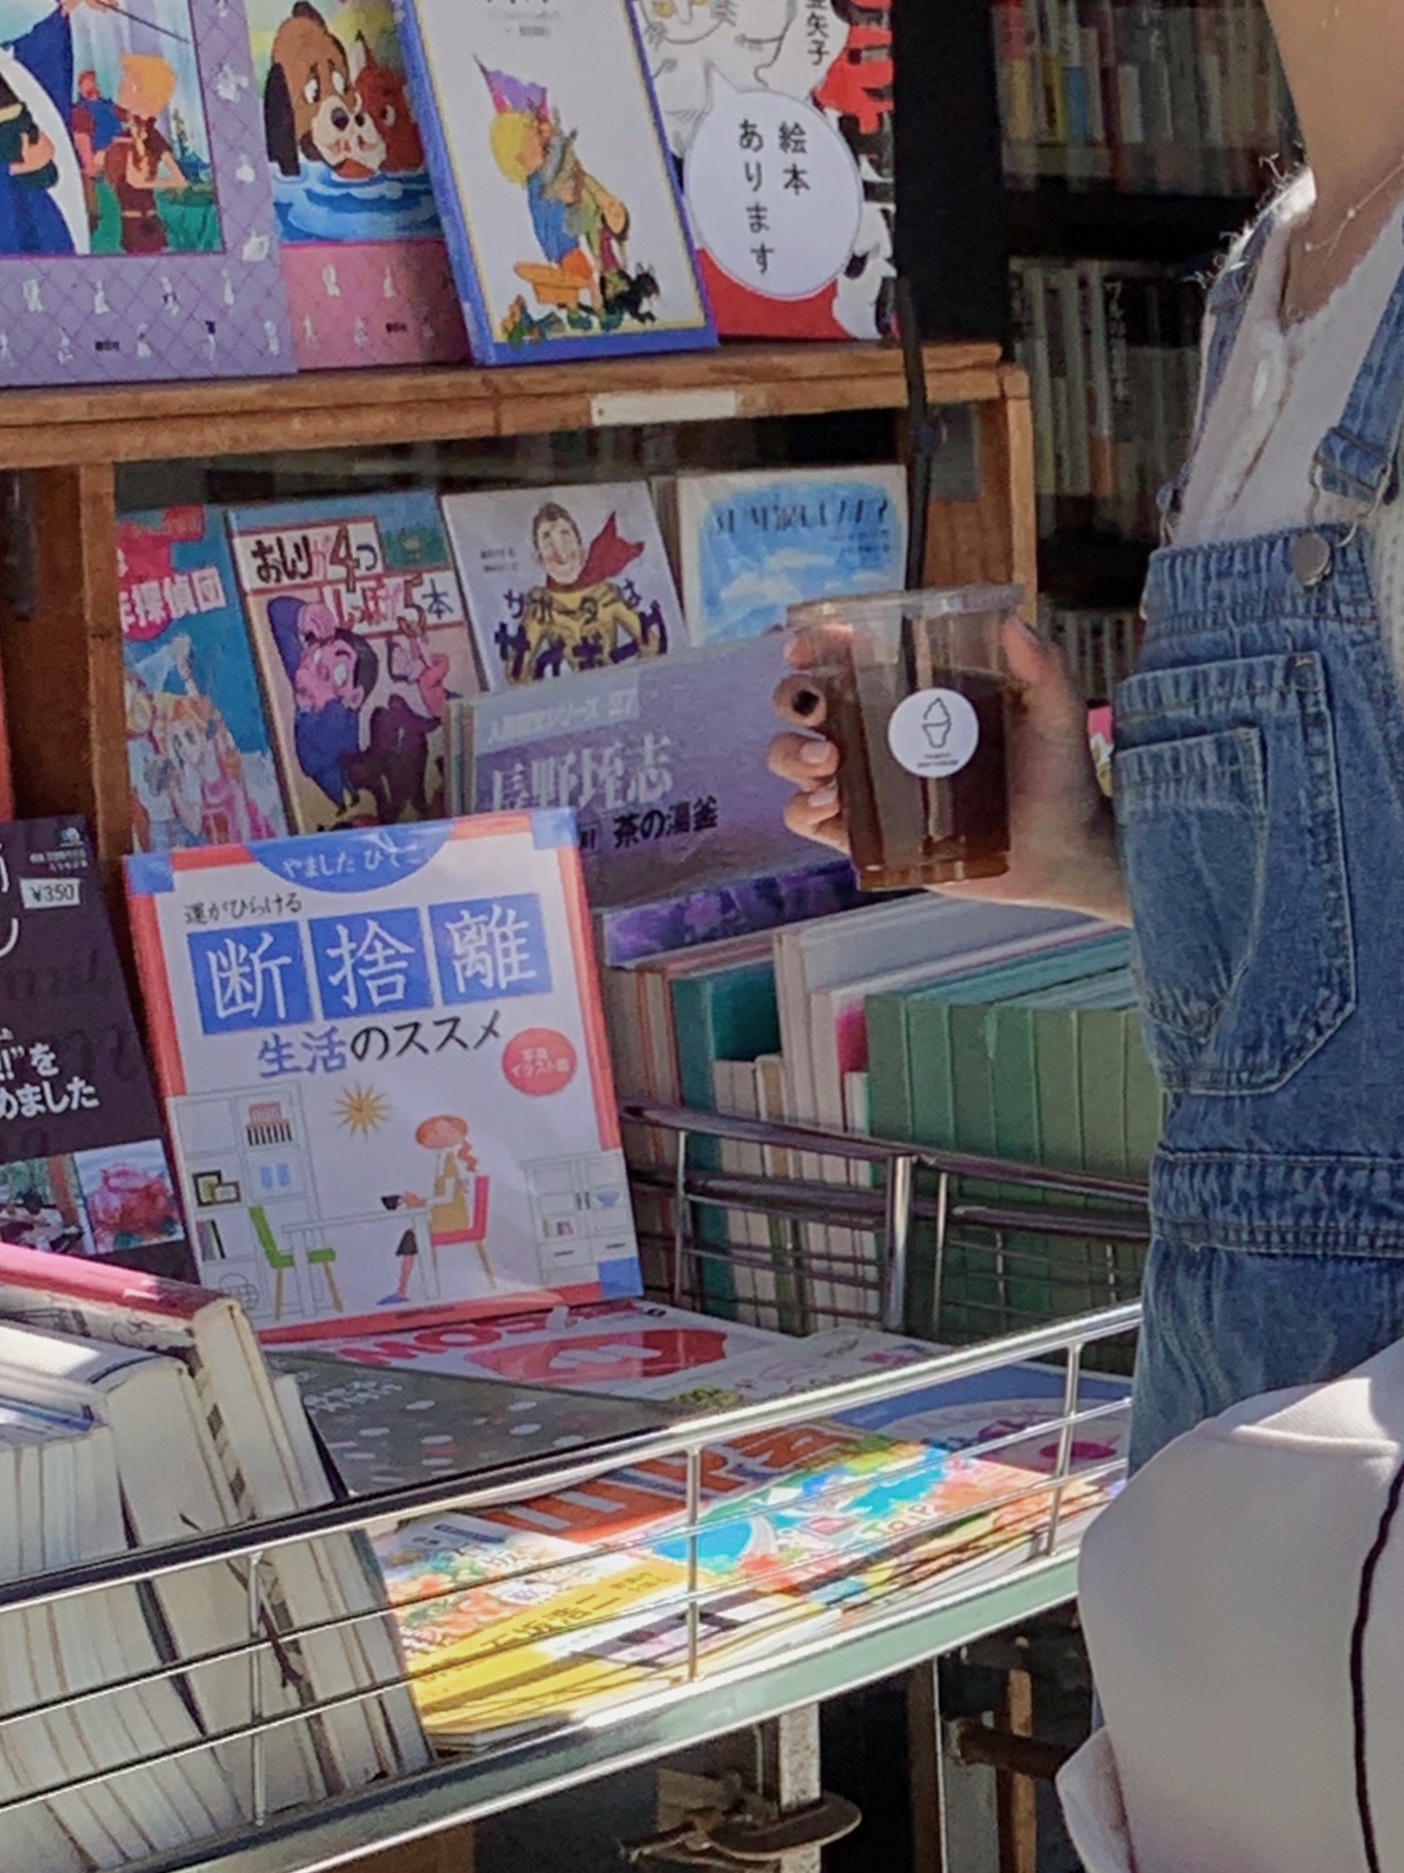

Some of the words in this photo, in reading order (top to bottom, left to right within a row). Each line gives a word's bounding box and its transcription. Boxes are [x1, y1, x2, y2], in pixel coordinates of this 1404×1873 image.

[778, 121, 810, 195] 絵本
[738, 119, 775, 274] あります
[613, 794, 719, 849] 茶の湯釜
[30, 882, 76, 903] ¥350
[281, 852, 356, 880] やました
[183, 892, 303, 926] 運がひらける
[208, 903, 540, 1021] 断捨離
[256, 1009, 502, 1079] 生活のススメ
